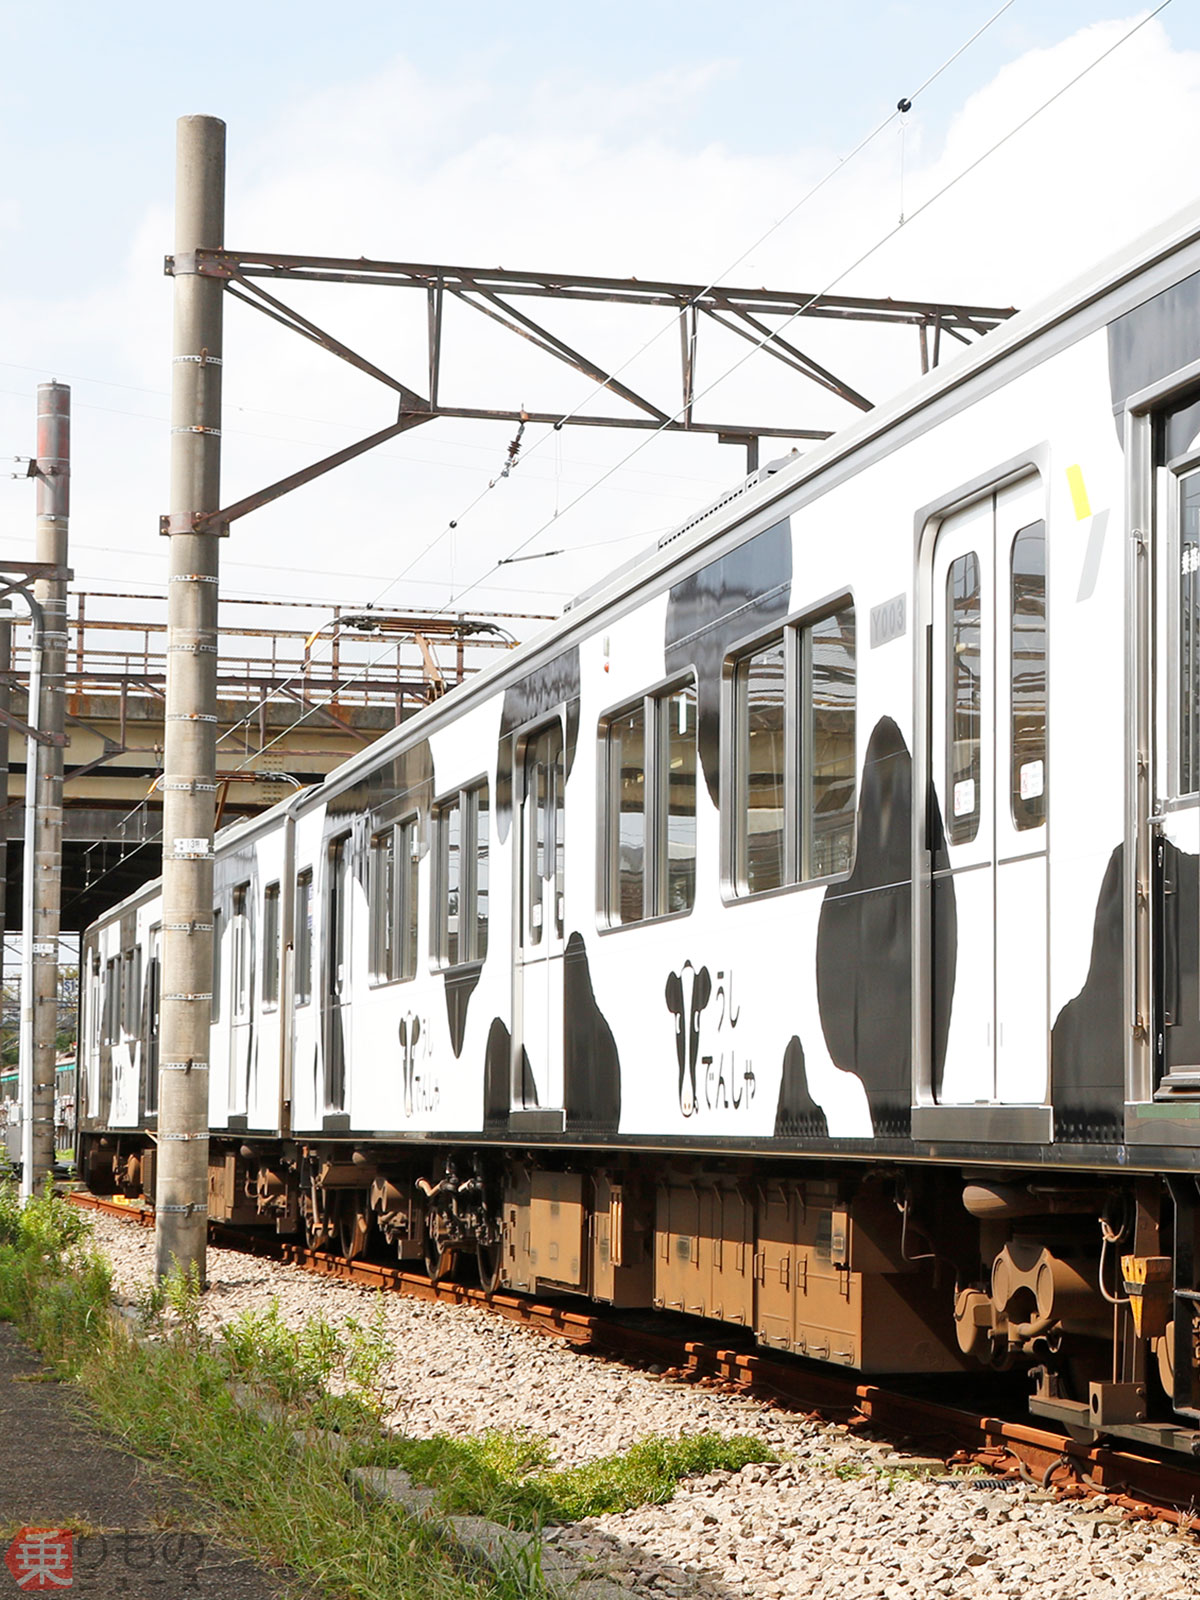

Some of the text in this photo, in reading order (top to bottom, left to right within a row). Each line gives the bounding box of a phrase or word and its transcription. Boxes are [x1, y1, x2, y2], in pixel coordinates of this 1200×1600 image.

[872, 599, 905, 642] Y003
[715, 968, 741, 1032] うし
[701, 1050, 756, 1110] でんしゃ
